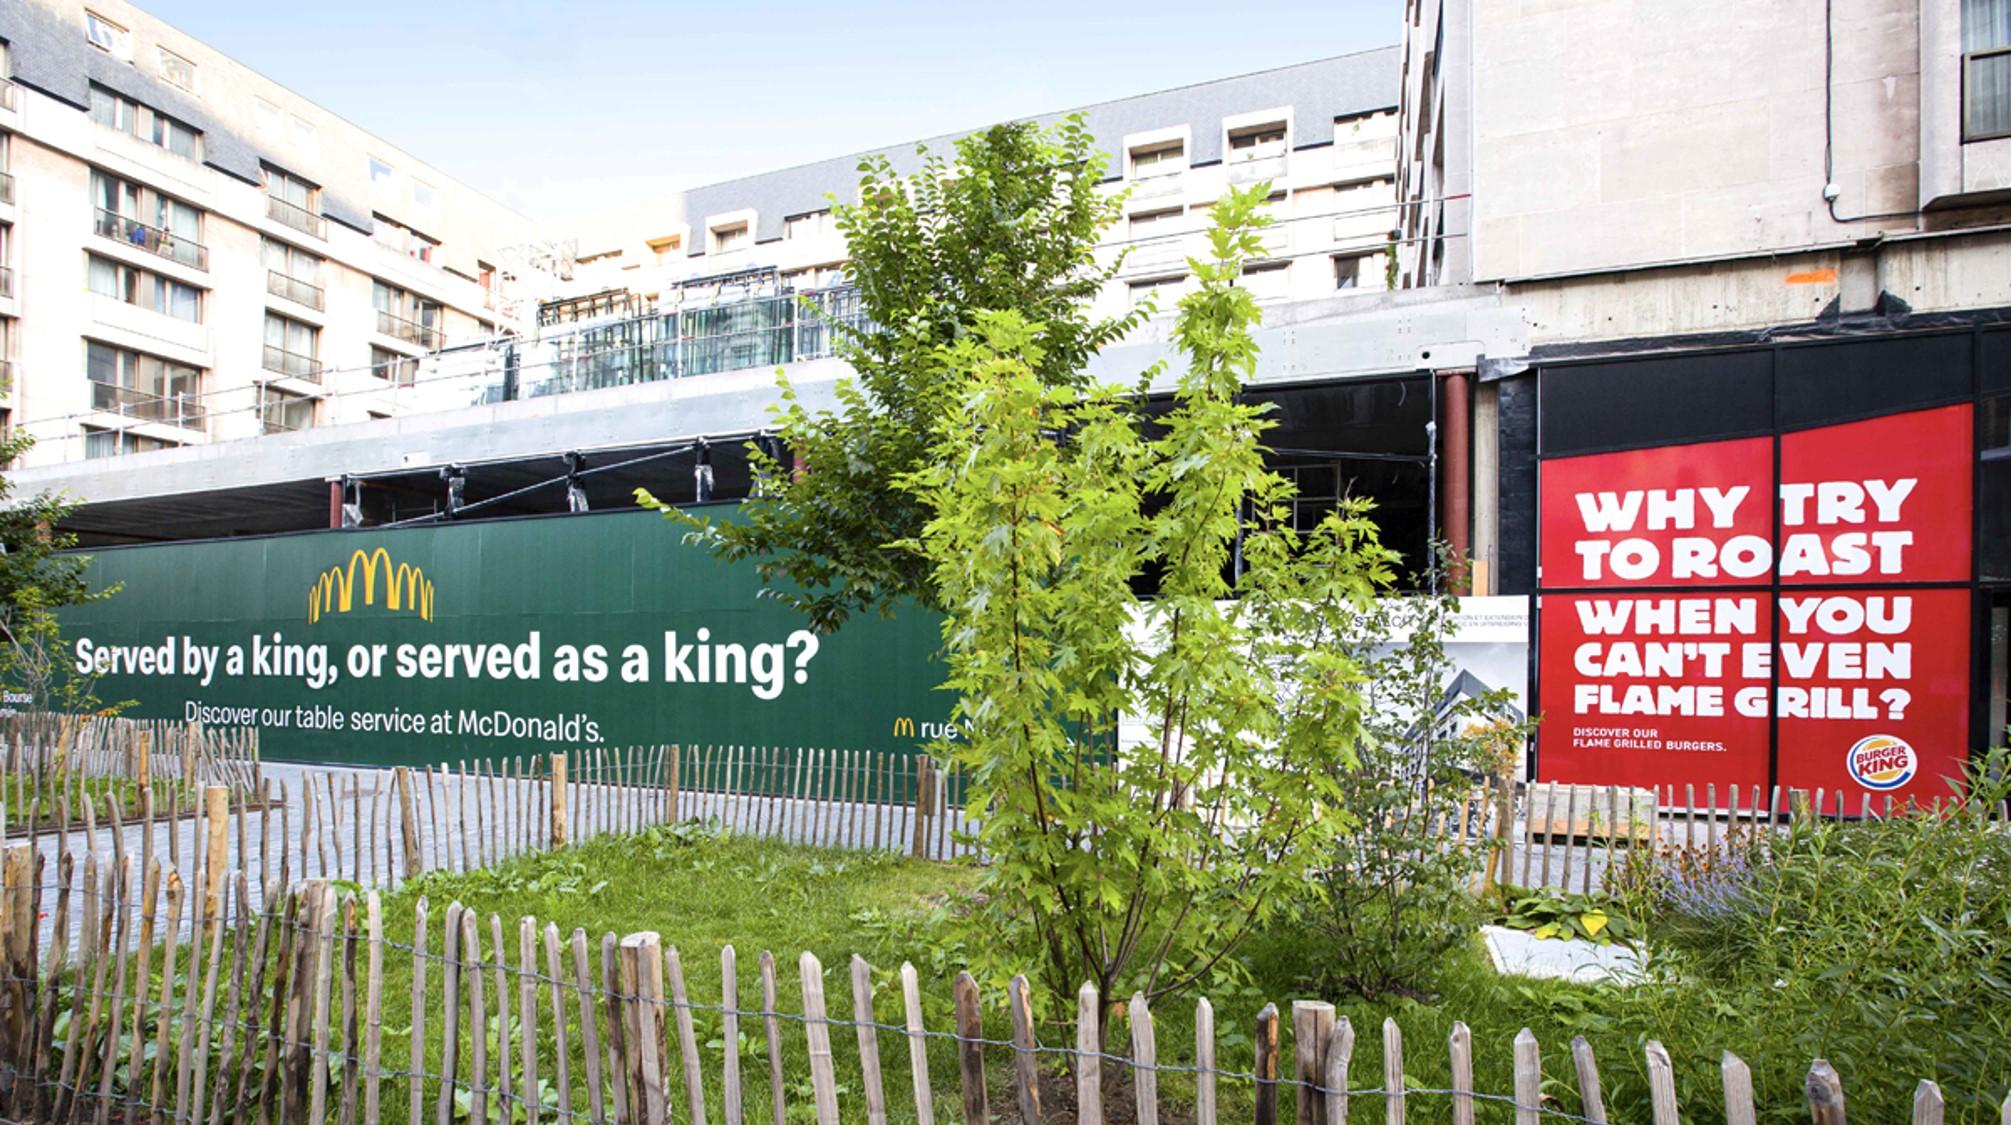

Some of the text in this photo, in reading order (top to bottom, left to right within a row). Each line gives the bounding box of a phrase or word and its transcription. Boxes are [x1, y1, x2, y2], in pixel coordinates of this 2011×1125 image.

[1575, 478, 1918, 532] WHY TRY
[1575, 531, 1913, 580] TO ROAST
[1574, 596, 1912, 635] WHEN YOU
[75, 627, 820, 700] Served by a king, or served as a king?
[1574, 642, 1912, 679] CAN'T EVEN
[1574, 684, 1912, 720] FLAME GRILL?
[185, 701, 605, 743] Discover our table service at McDonald's.
[921, 721, 958, 738] rue
[1573, 727, 1658, 738] DISCOVER OUR
[1573, 738, 1727, 752] FLAME GRILLED BURGERS.
[1856, 745, 1906, 764] BURGER
[1858, 755, 1908, 777] KING
